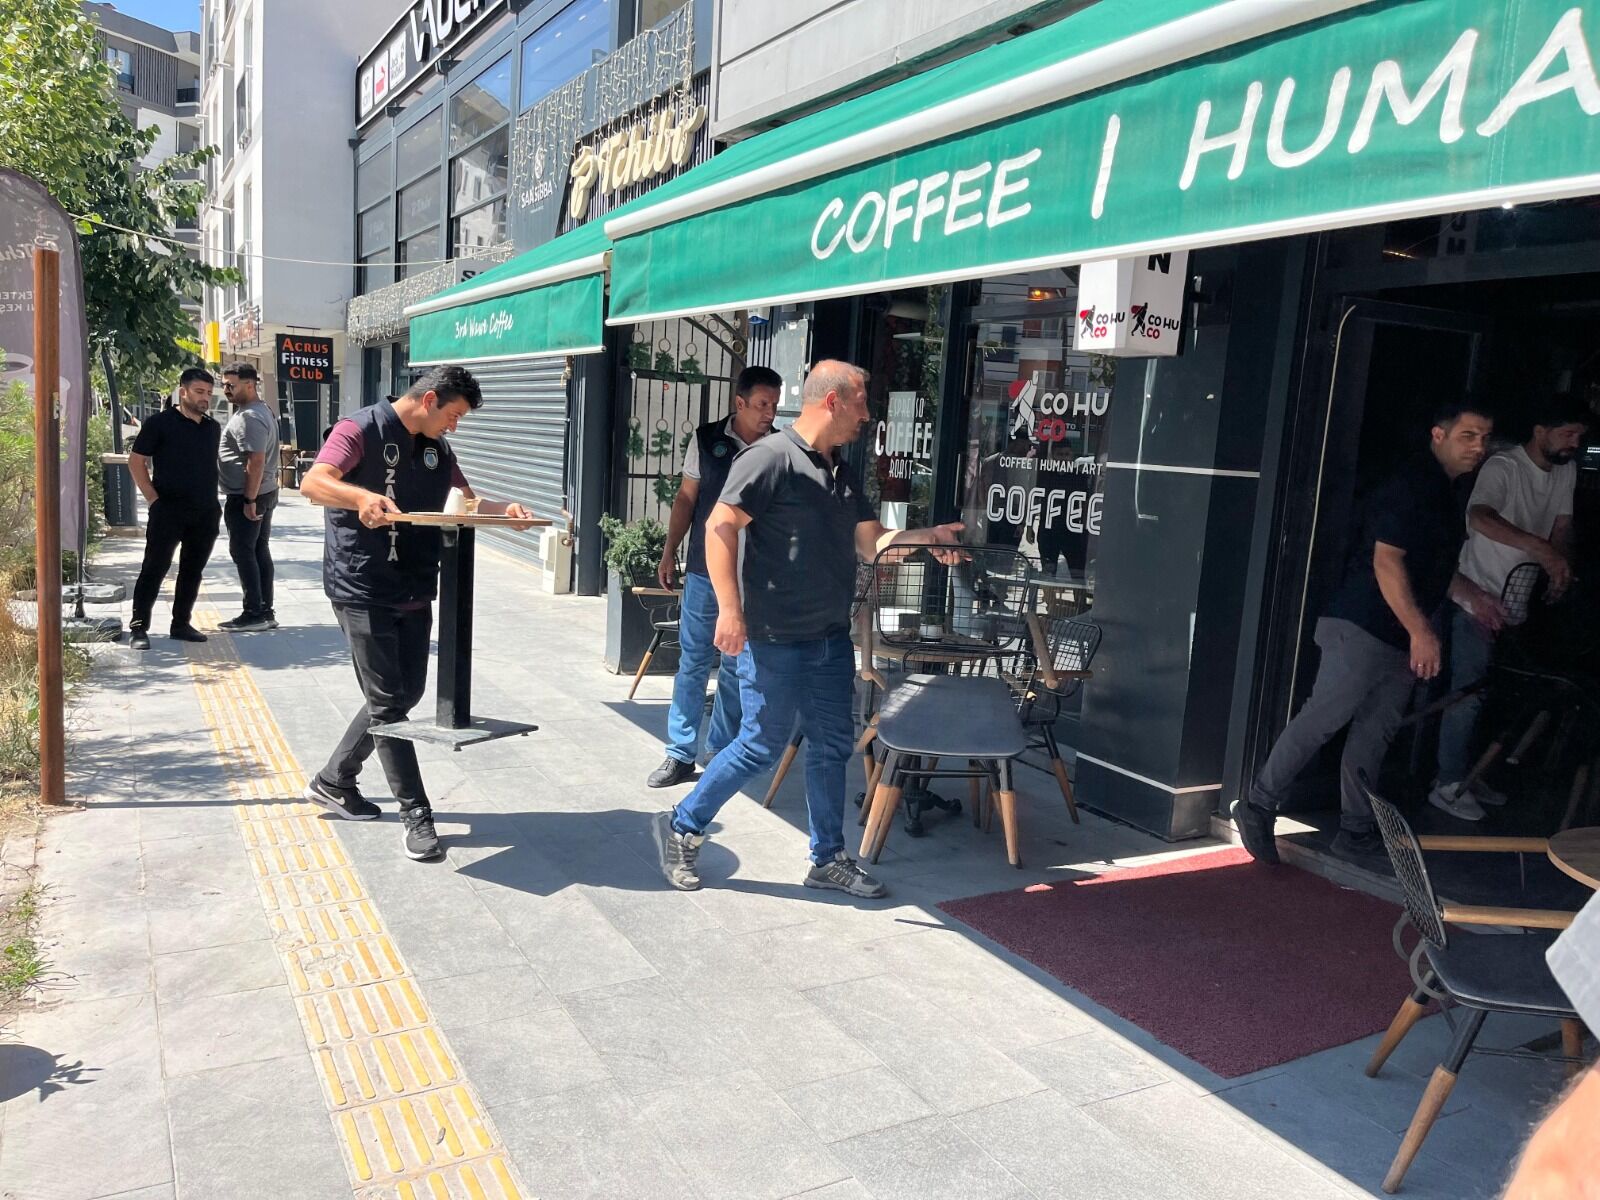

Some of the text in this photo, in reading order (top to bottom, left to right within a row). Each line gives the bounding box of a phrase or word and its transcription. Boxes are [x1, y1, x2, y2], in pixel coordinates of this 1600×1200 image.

[811, 148, 1042, 260] COFFEE
[1178, 7, 1600, 191] HUMA
[598, 104, 707, 196] Tchibo
[455, 317, 468, 339] 3rd
[489, 310, 514, 340] Coffee
[1096, 312, 1126, 325] CO HU
[1148, 314, 1180, 331] CO HU
[1094, 326, 1107, 338] CO
[1146, 327, 1160, 339] CO
[289, 366, 324, 380] Club
[1040, 392, 1110, 417] CO HU
[874, 420, 933, 460] COFFEE
[1037, 418, 1067, 442] CO
[889, 458, 914, 480] ROAST
[999, 456, 1033, 470] COFFEE
[1039, 459, 1074, 473] HUMAN
[1081, 463, 1103, 476] ART
[986, 483, 1105, 536] COFFEE
